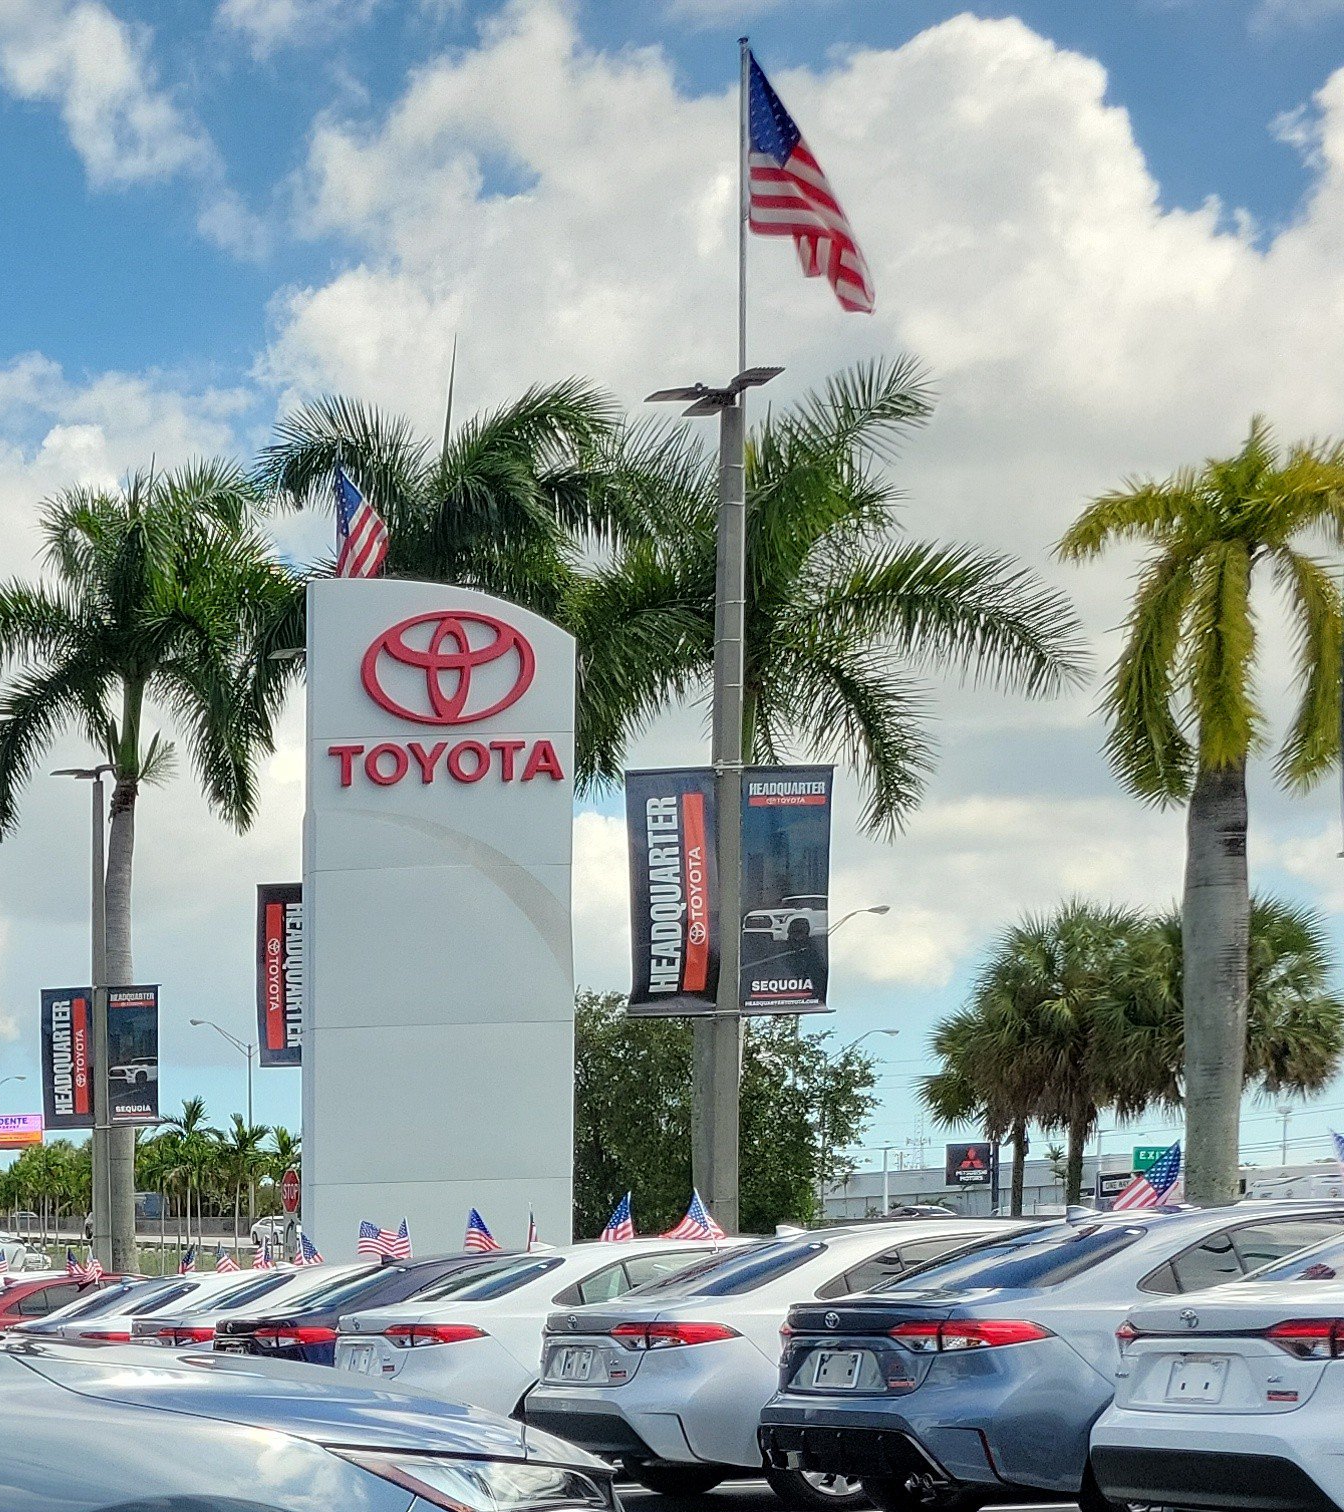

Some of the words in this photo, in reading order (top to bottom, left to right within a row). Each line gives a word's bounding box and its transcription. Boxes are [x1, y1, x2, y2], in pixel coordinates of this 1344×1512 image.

[328, 740, 565, 787] TOYOTA
[749, 781, 826, 796] HEADQUARTER
[646, 795, 687, 993] HEADQUARTER
[689, 846, 703, 921] TOYOTA
[268, 956, 280, 1011] TOYOTA
[751, 978, 814, 993] SEQUOIA
[52, 999, 74, 1115] HEADQUARTER
[76, 1029, 85, 1073] TOYOTA
[1139, 1150, 1167, 1160] EXI
[283, 1182, 299, 1200] STOP
